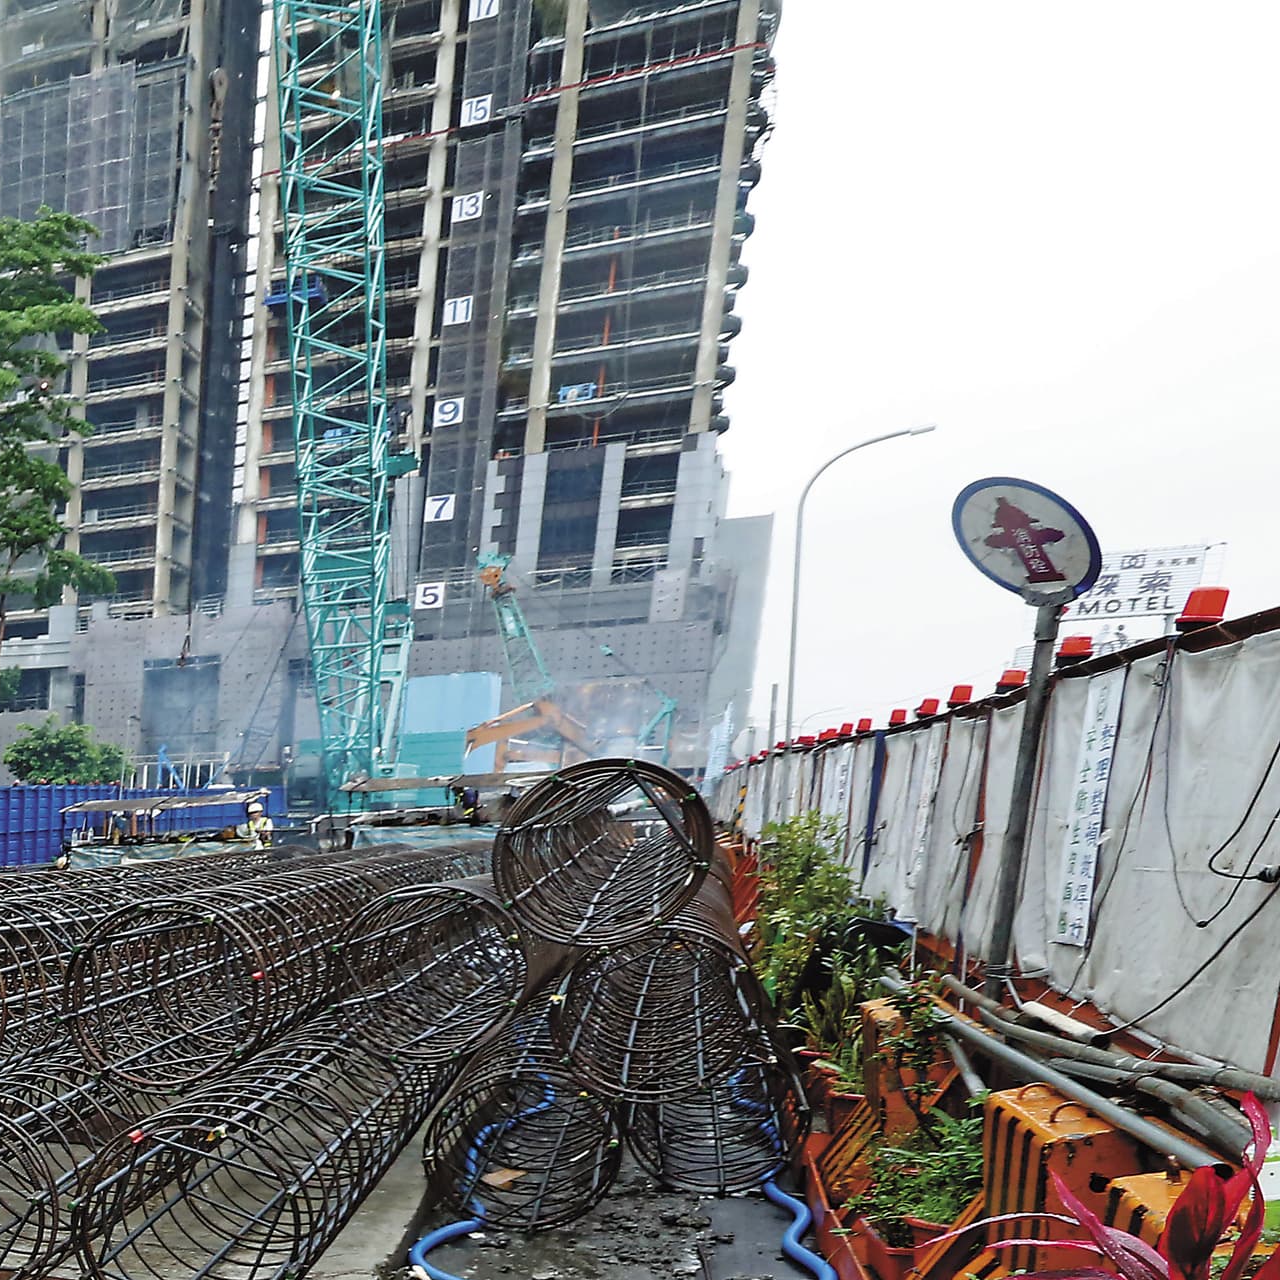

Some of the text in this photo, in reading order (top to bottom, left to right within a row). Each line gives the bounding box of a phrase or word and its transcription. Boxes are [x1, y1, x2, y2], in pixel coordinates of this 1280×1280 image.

[464, 97, 488, 124] 15
[455, 194, 480, 219] 13
[447, 297, 472, 323] 11
[438, 400, 460, 424] 9
[431, 495, 451, 520] 7
[420, 585, 440, 606] 5
[1077, 594, 1175, 616] MOTEL
